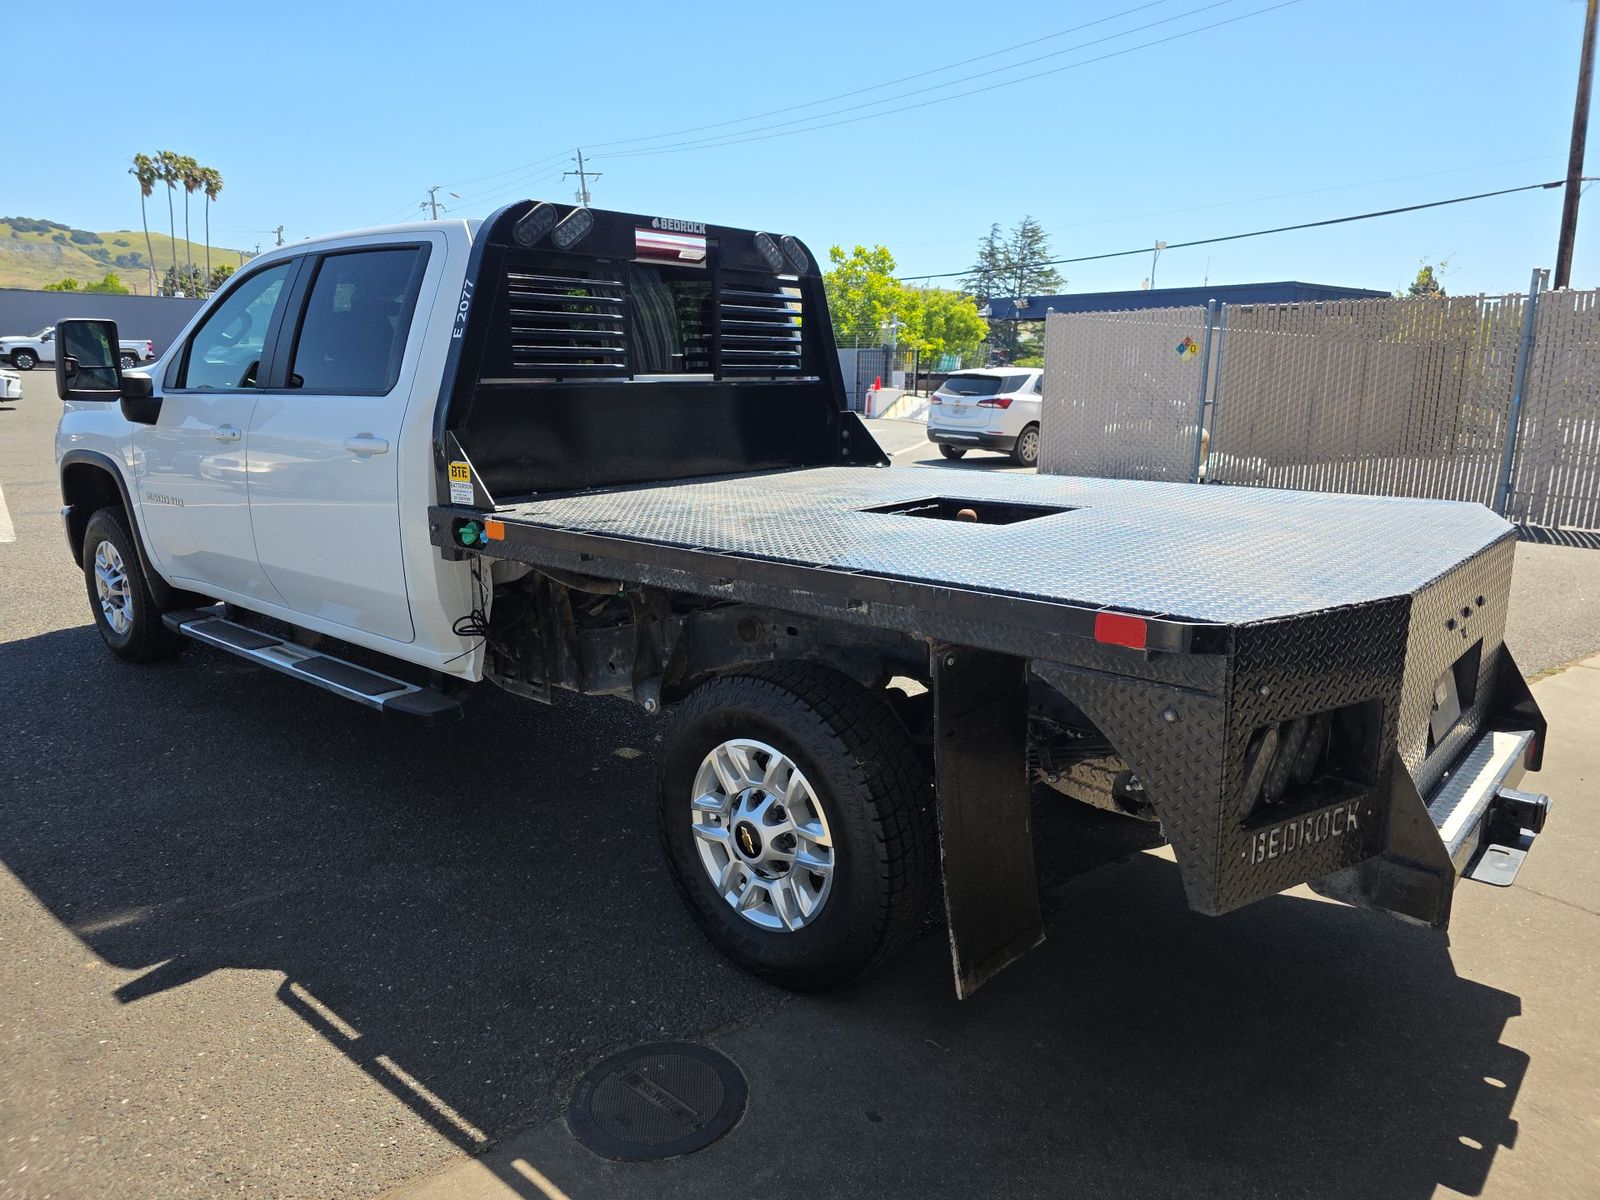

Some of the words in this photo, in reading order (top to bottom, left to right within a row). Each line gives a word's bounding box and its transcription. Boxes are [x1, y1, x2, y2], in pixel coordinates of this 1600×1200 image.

[661, 218, 706, 234] BEDROCK
[457, 279, 474, 322] 2077
[453, 328, 463, 338] E
[1190, 344, 1197, 354] 0
[451, 465, 468, 479] BTE
[1251, 801, 1360, 865] BEDROCK
[639, 1082, 676, 1113] SEWER
